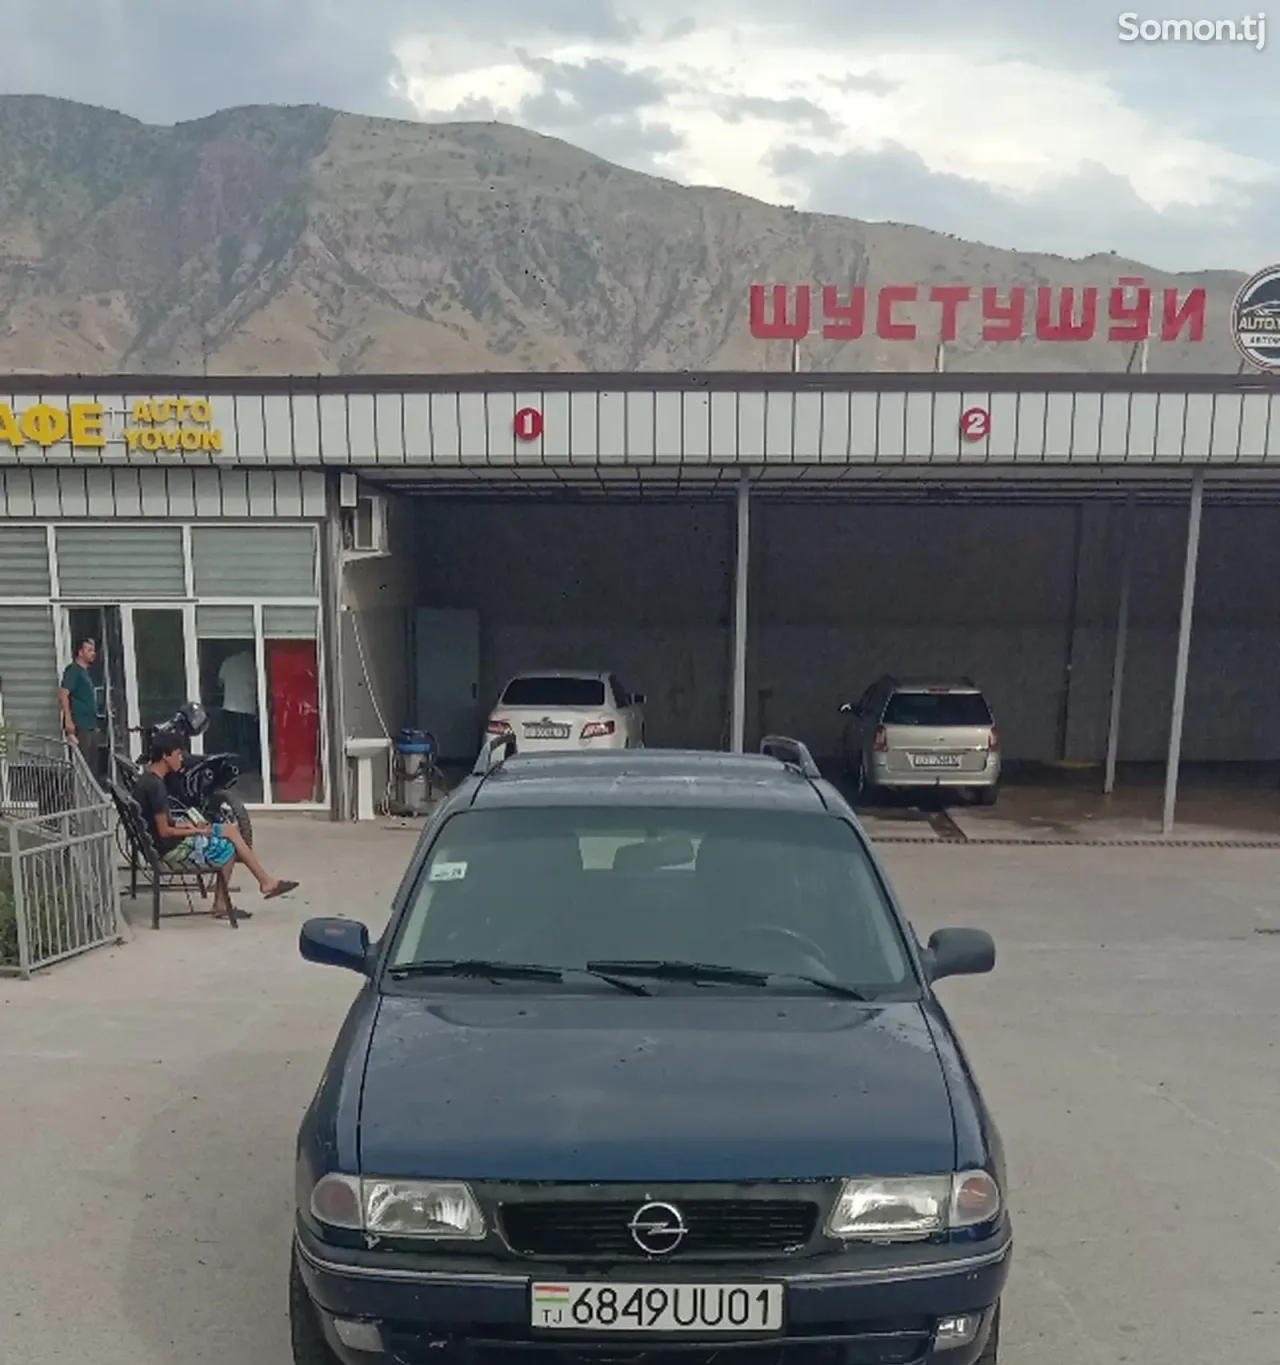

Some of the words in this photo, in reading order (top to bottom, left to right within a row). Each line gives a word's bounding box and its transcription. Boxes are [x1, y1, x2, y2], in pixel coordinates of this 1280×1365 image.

[132, 400, 212, 422] AUTO
[523, 413, 533, 434] 1
[967, 413, 985, 434] 2
[124, 428, 223, 451] YOVON
[541, 1309, 562, 1323] TJ
[572, 1287, 769, 1326] 6849UU01
